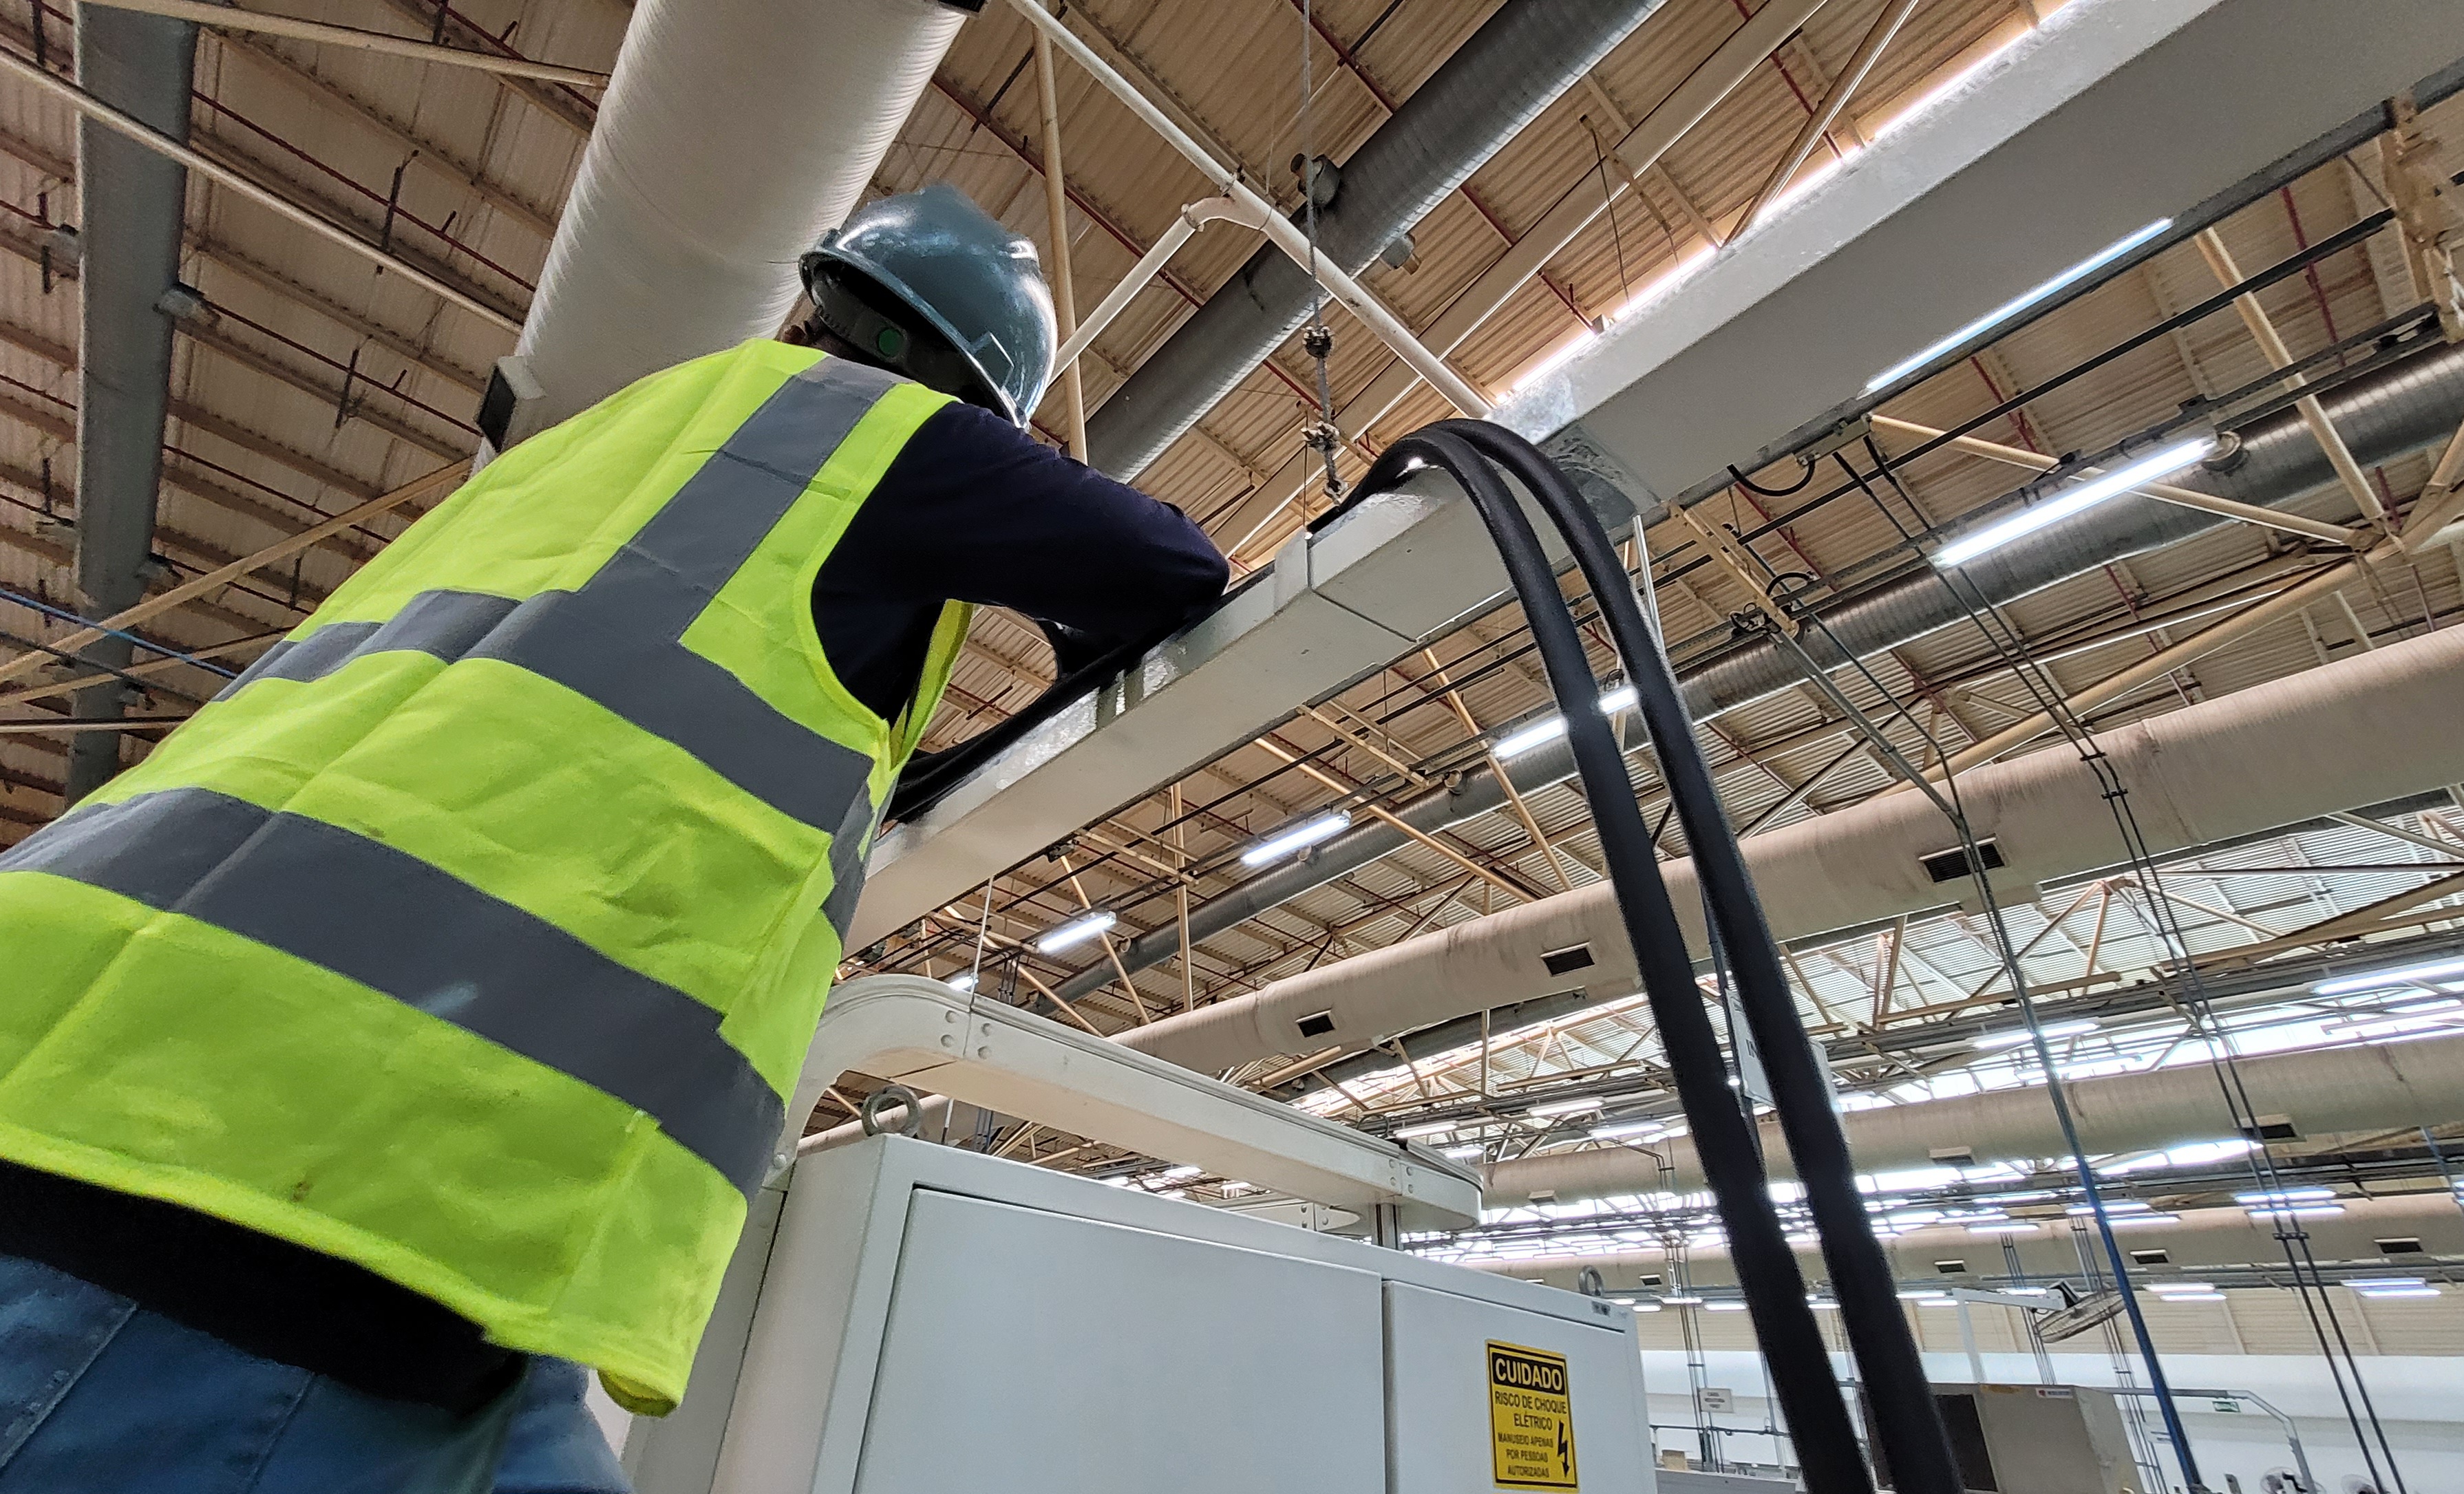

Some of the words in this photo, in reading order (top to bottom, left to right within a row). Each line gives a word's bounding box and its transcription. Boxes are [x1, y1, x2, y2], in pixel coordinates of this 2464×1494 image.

[1495, 1358, 1562, 1391] CUIDADO
[1495, 1391, 1520, 1408] RISCO
[1522, 1395, 1533, 1409] DE
[1534, 1397, 1567, 1414] CHOQUE
[1514, 1411, 1552, 1430] ELÉTRICO
[1531, 1436, 1553, 1448] APENAS
[1506, 1449, 1520, 1460] POR
[1520, 1450, 1549, 1463] PESSOAS
[1507, 1465, 1549, 1477] AUTORIZADAS
